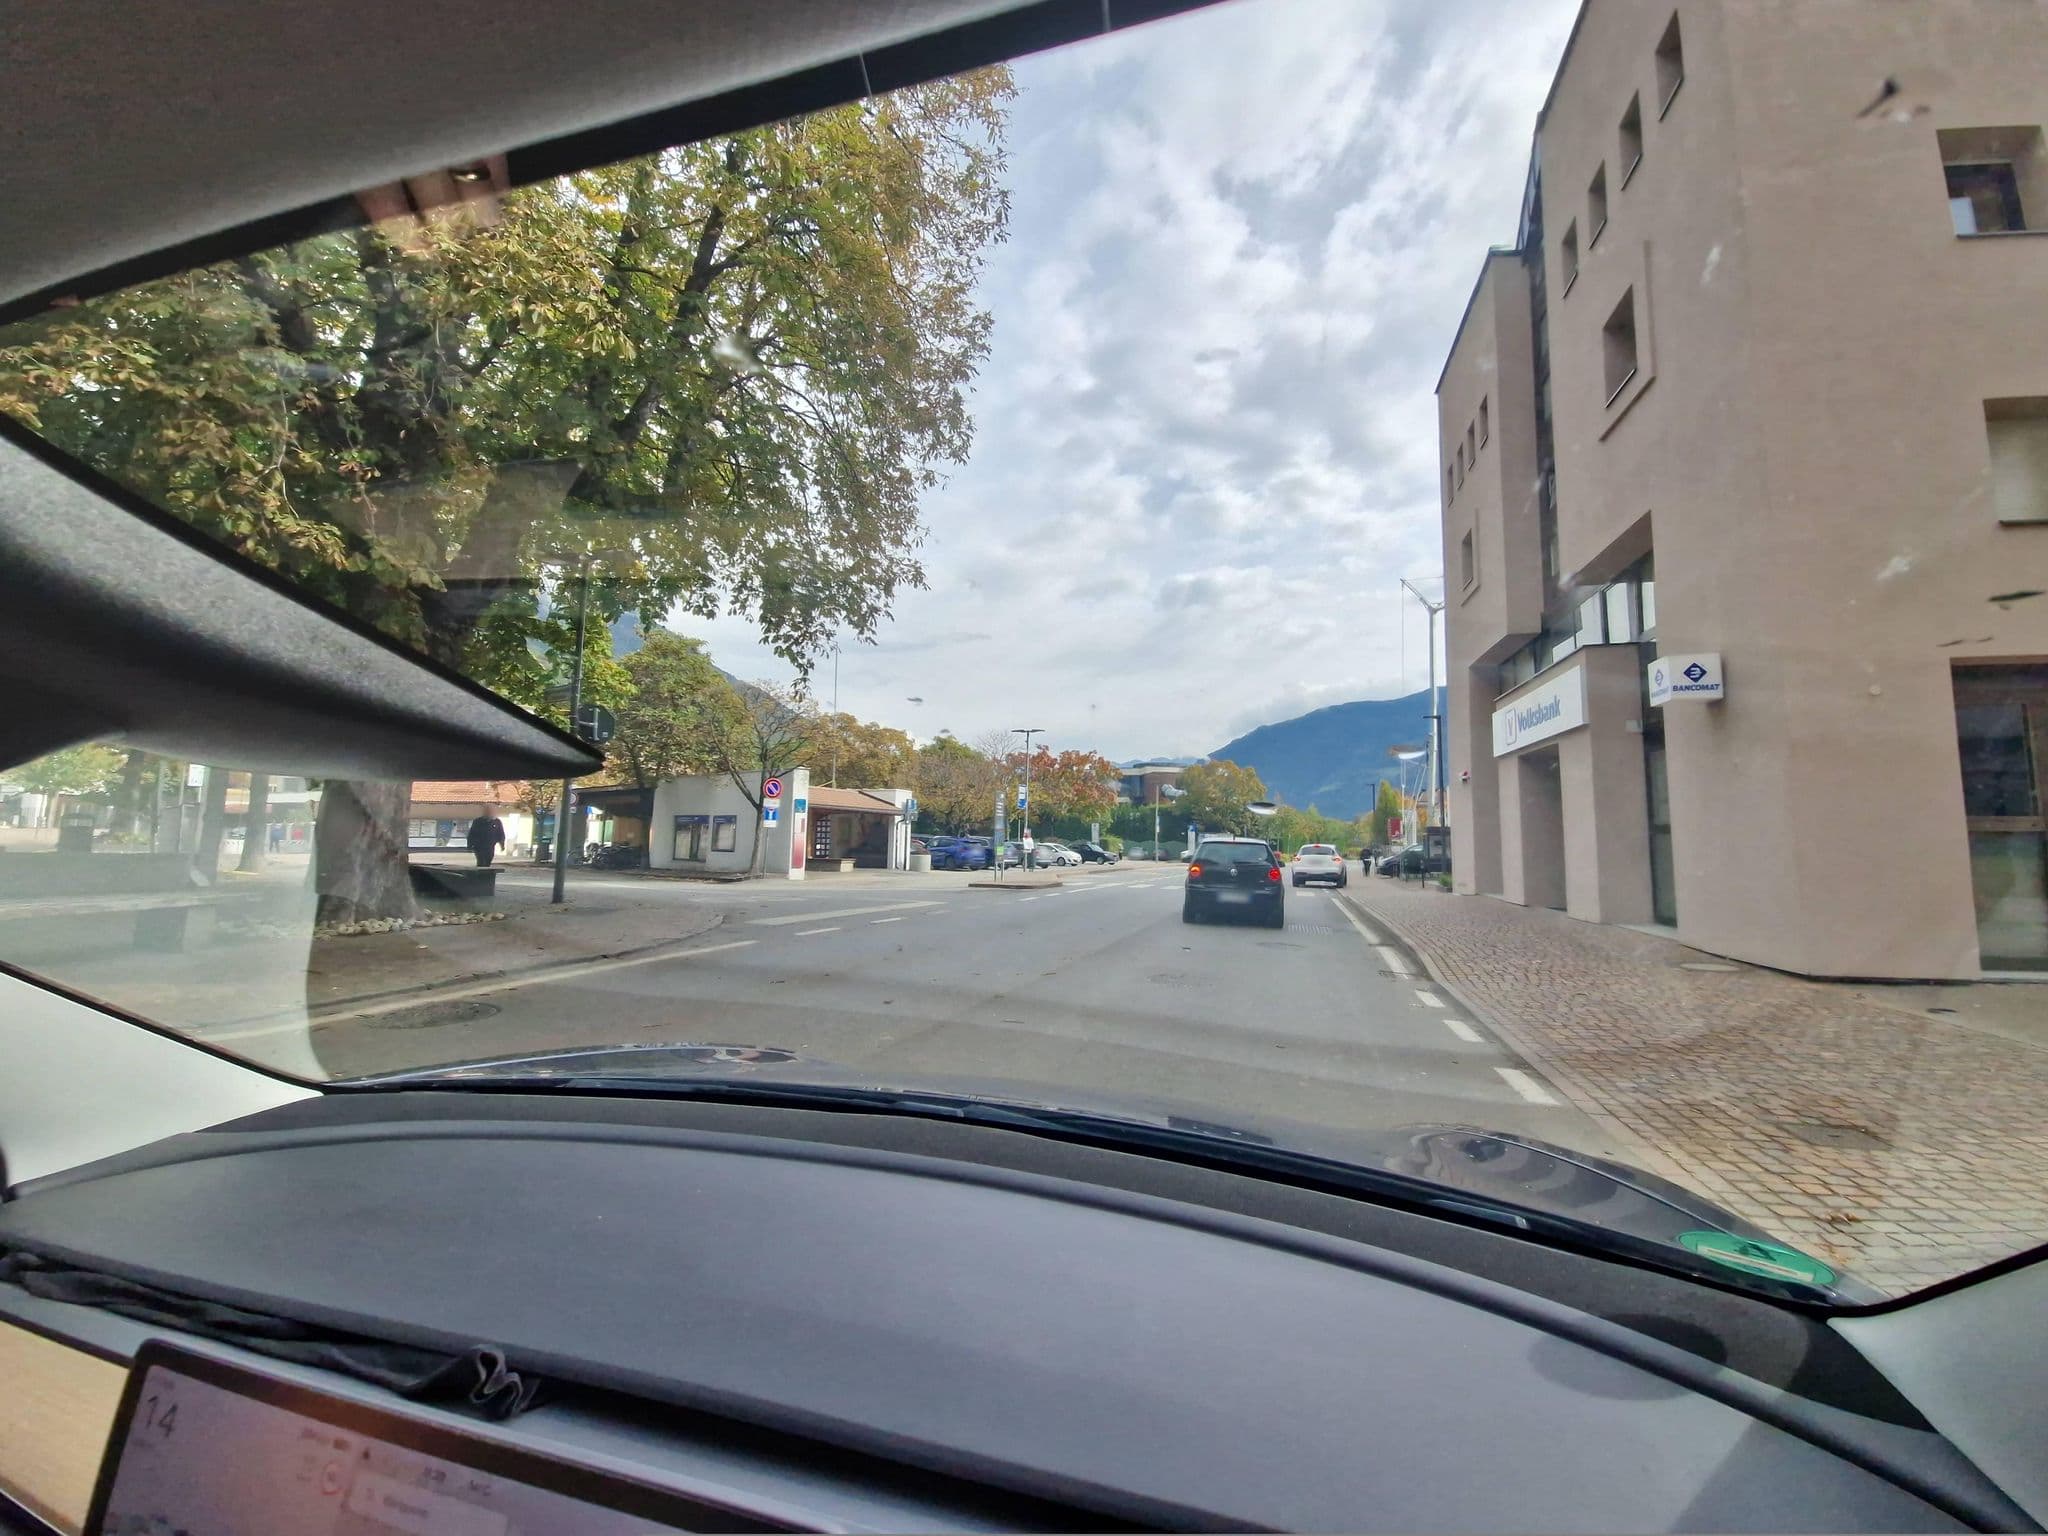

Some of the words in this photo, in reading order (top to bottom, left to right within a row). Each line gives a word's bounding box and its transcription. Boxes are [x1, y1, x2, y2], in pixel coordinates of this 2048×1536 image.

[1672, 683, 1721, 692] BANCOMAT
[1517, 694, 1561, 733] Volksbank
[145, 1395, 178, 1438] 14
